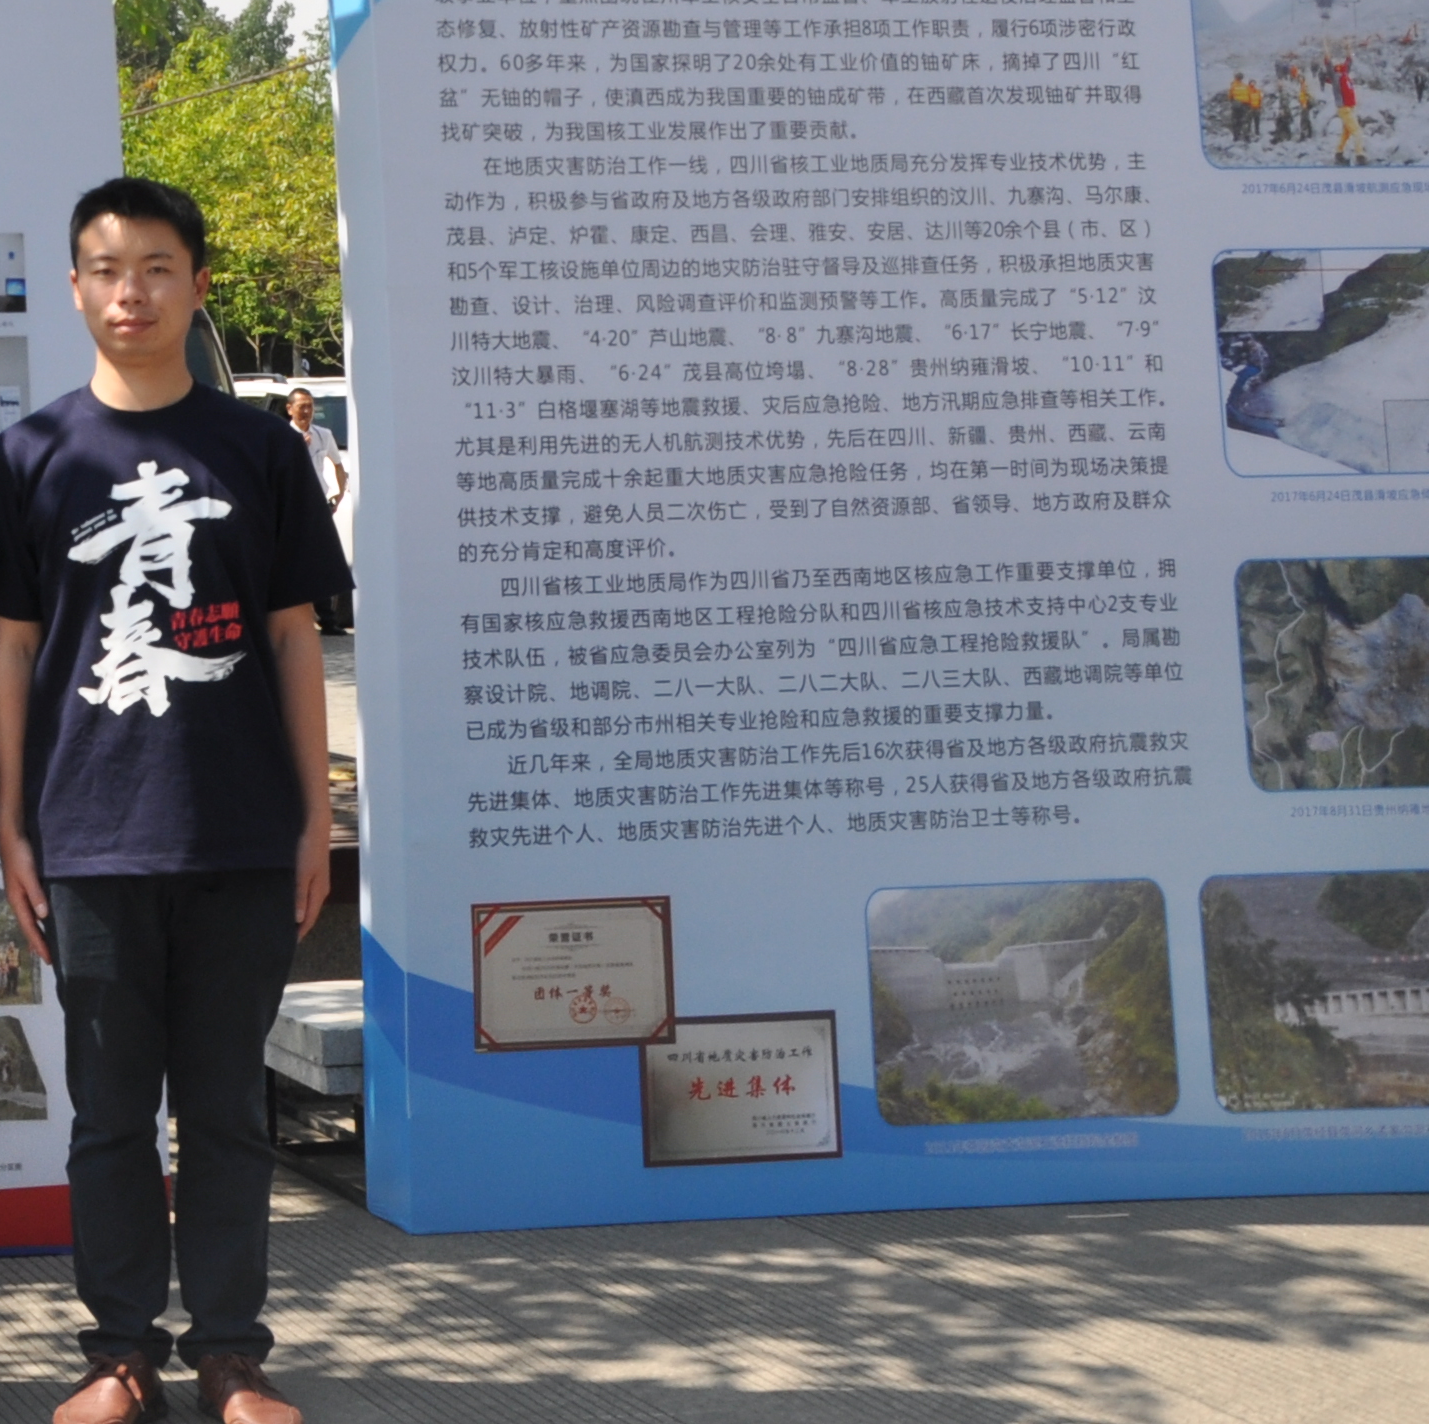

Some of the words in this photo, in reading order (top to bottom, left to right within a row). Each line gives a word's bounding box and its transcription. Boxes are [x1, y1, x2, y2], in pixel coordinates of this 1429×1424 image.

[67, 460, 247, 717] 青春
[688, 1074, 796, 1101] 先进集体
